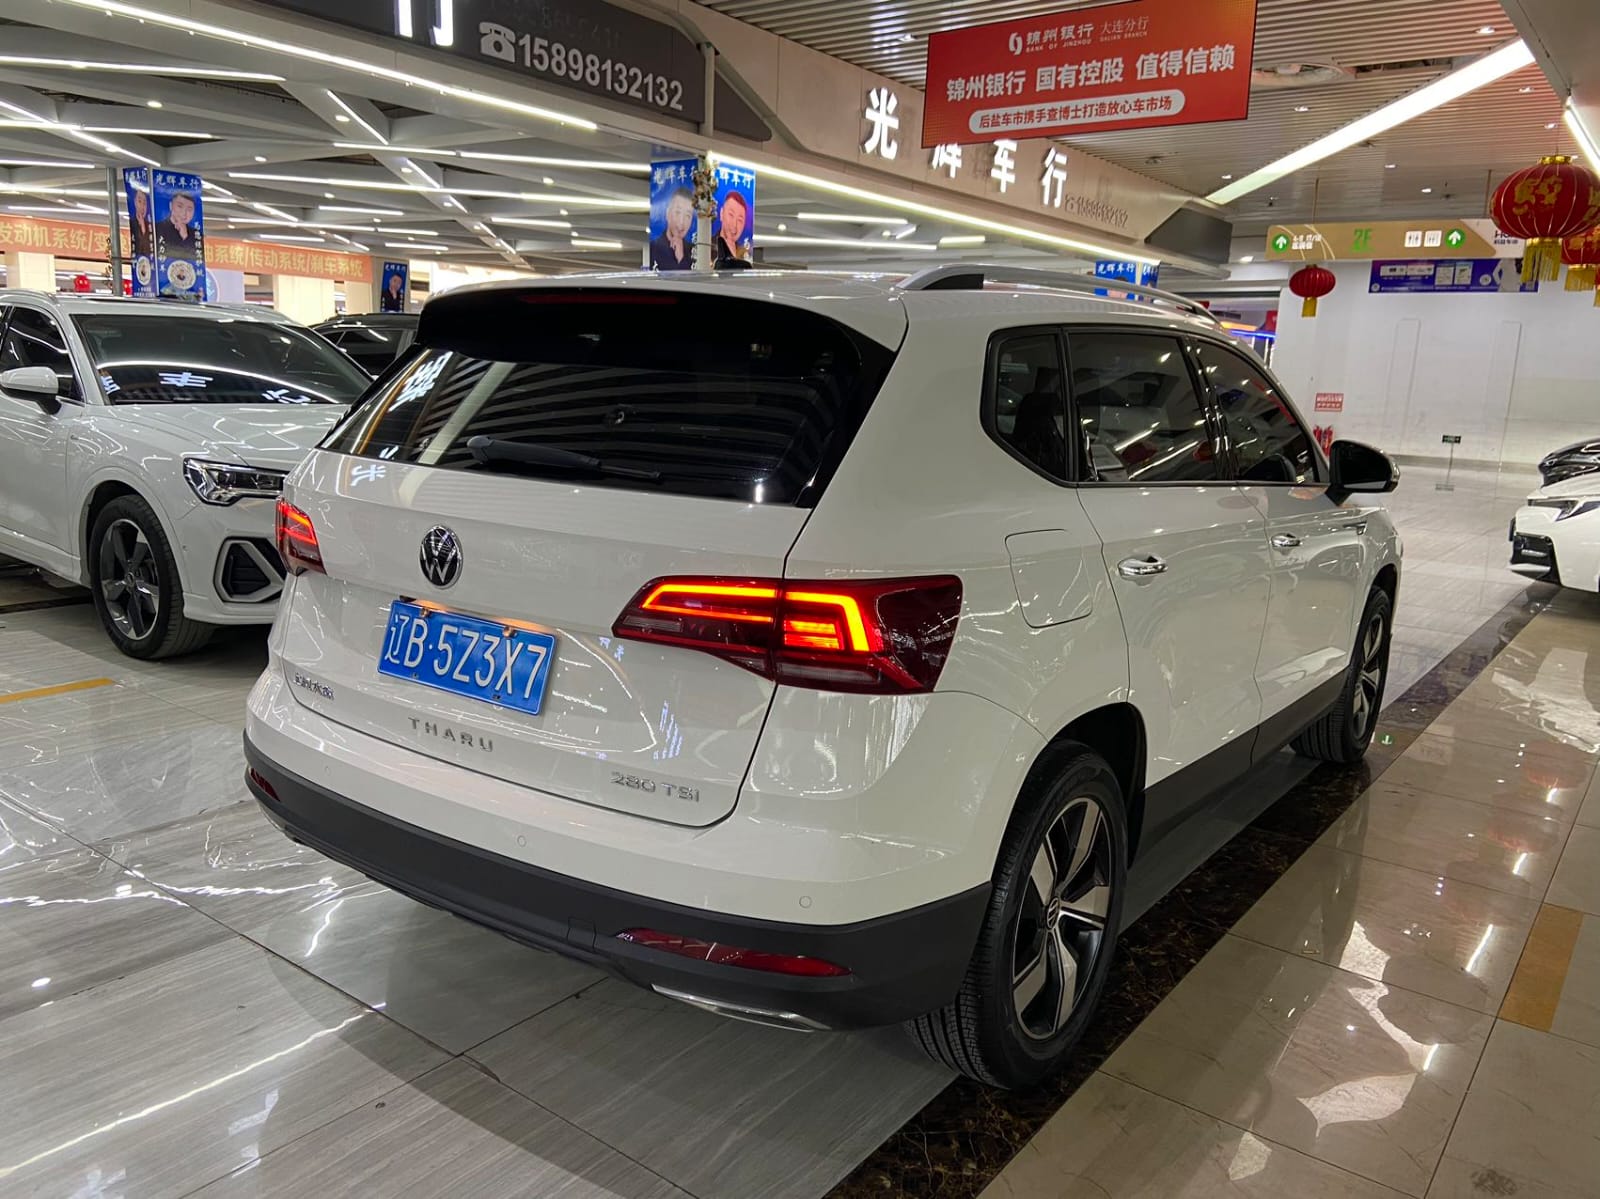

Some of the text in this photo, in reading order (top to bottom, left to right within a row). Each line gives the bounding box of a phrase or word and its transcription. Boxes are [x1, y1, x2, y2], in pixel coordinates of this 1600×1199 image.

[1101, 16, 1149, 35] 大连分行
[518, 33, 684, 112] 15898132132
[945, 44, 1236, 102] 锦州银行 国有控股 值得信赖
[978, 95, 1173, 129] 后盐车市携手查博士打造放心车市场
[407, 717, 494, 753] THARU
[610, 771, 700, 803] 280 TSI
